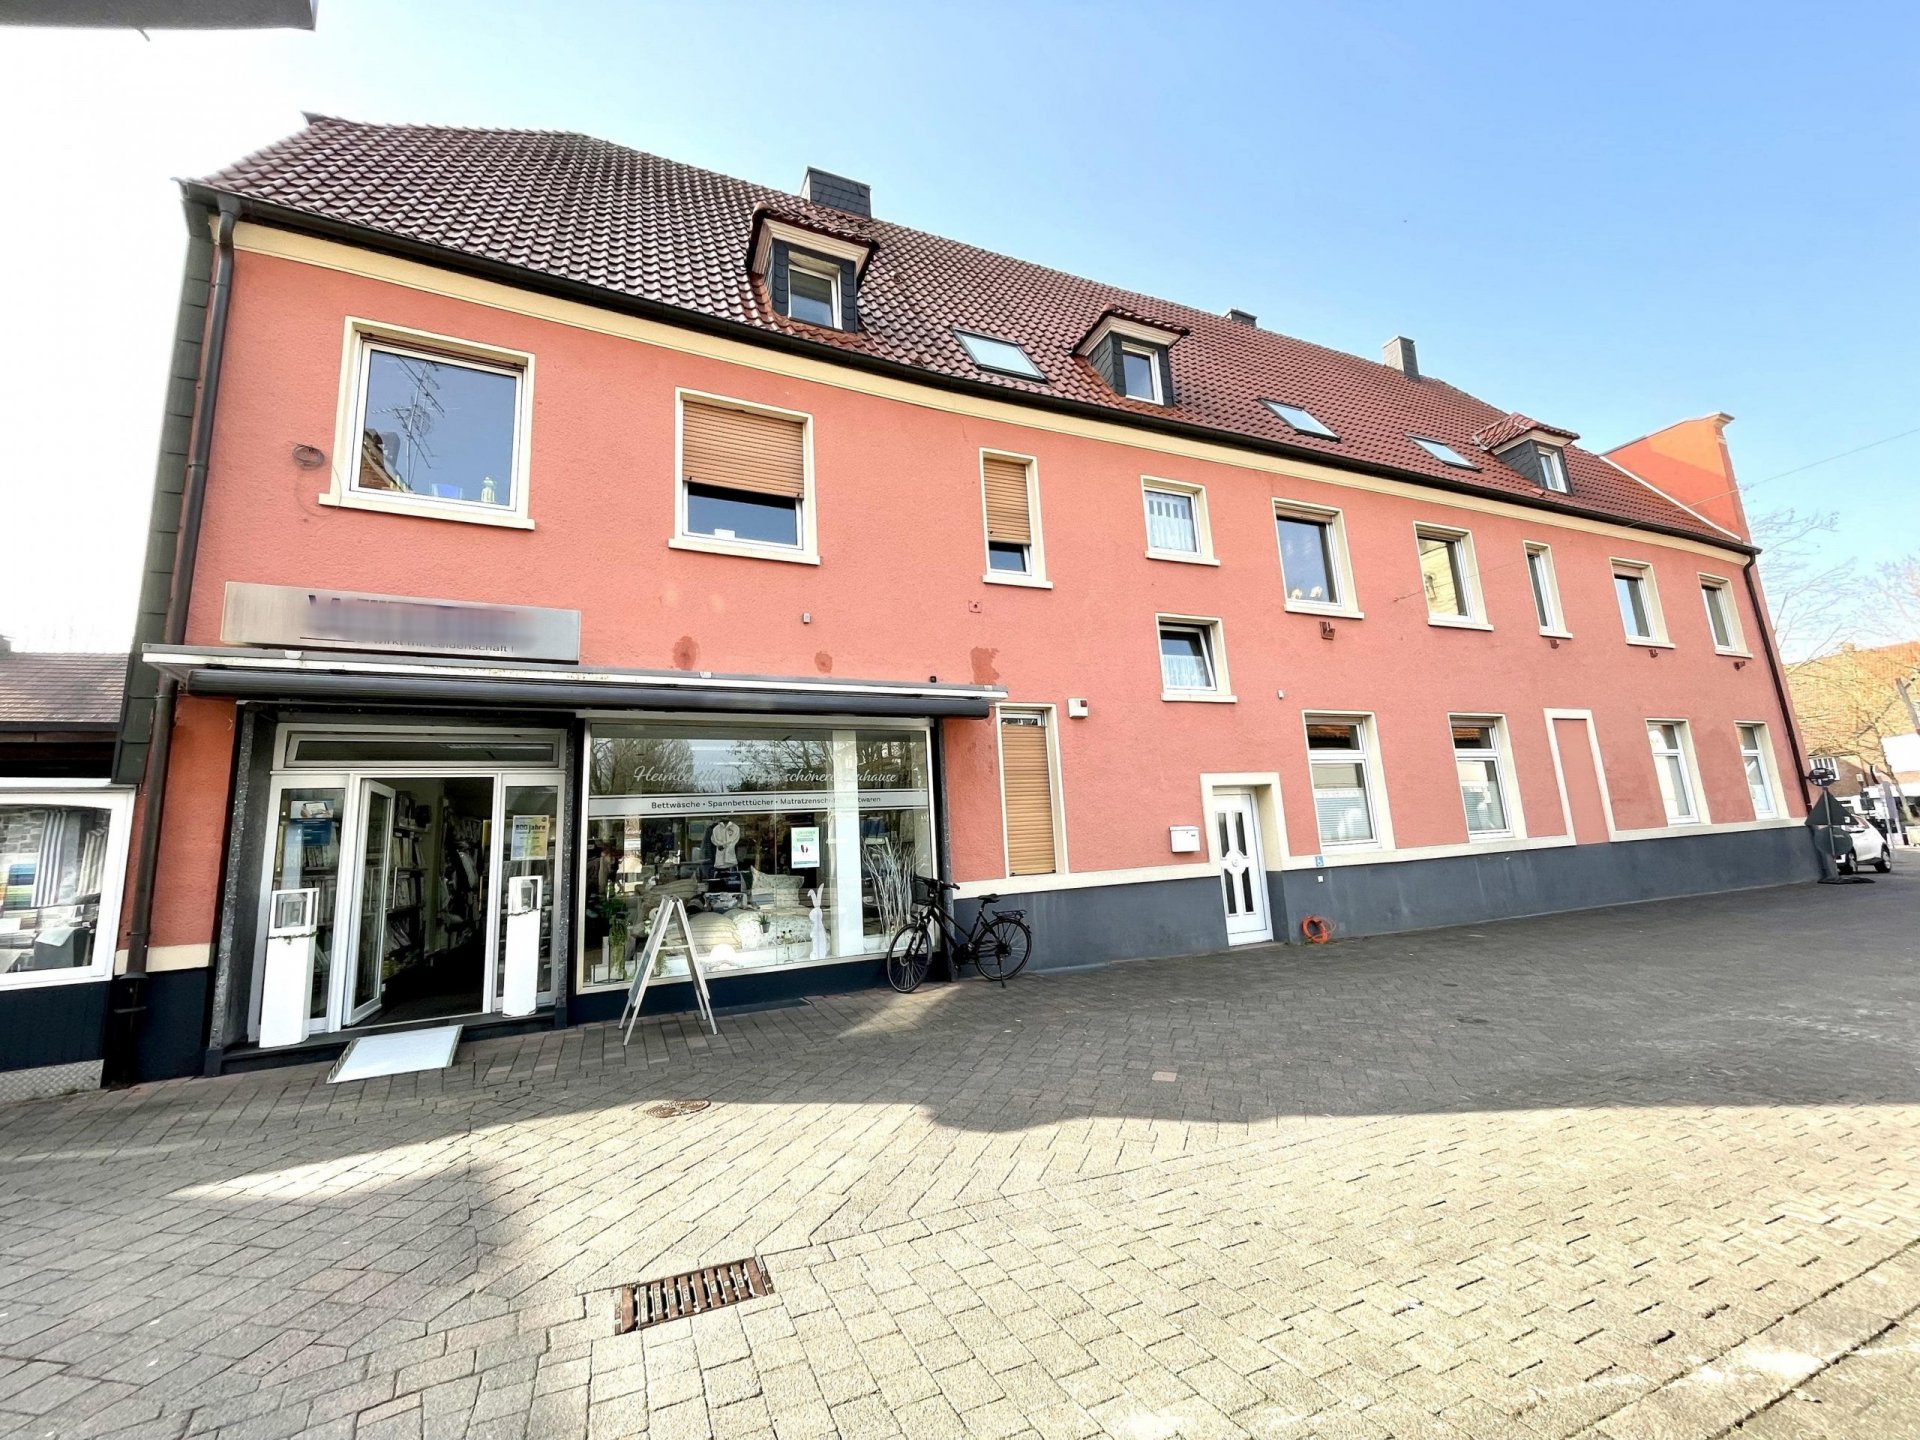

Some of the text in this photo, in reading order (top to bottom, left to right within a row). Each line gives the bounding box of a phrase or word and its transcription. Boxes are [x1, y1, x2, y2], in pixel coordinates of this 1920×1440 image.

[785, 769, 841, 782] schönere
[852, 769, 897, 783] uhause
[707, 799, 773, 809] Spannbetttücher
